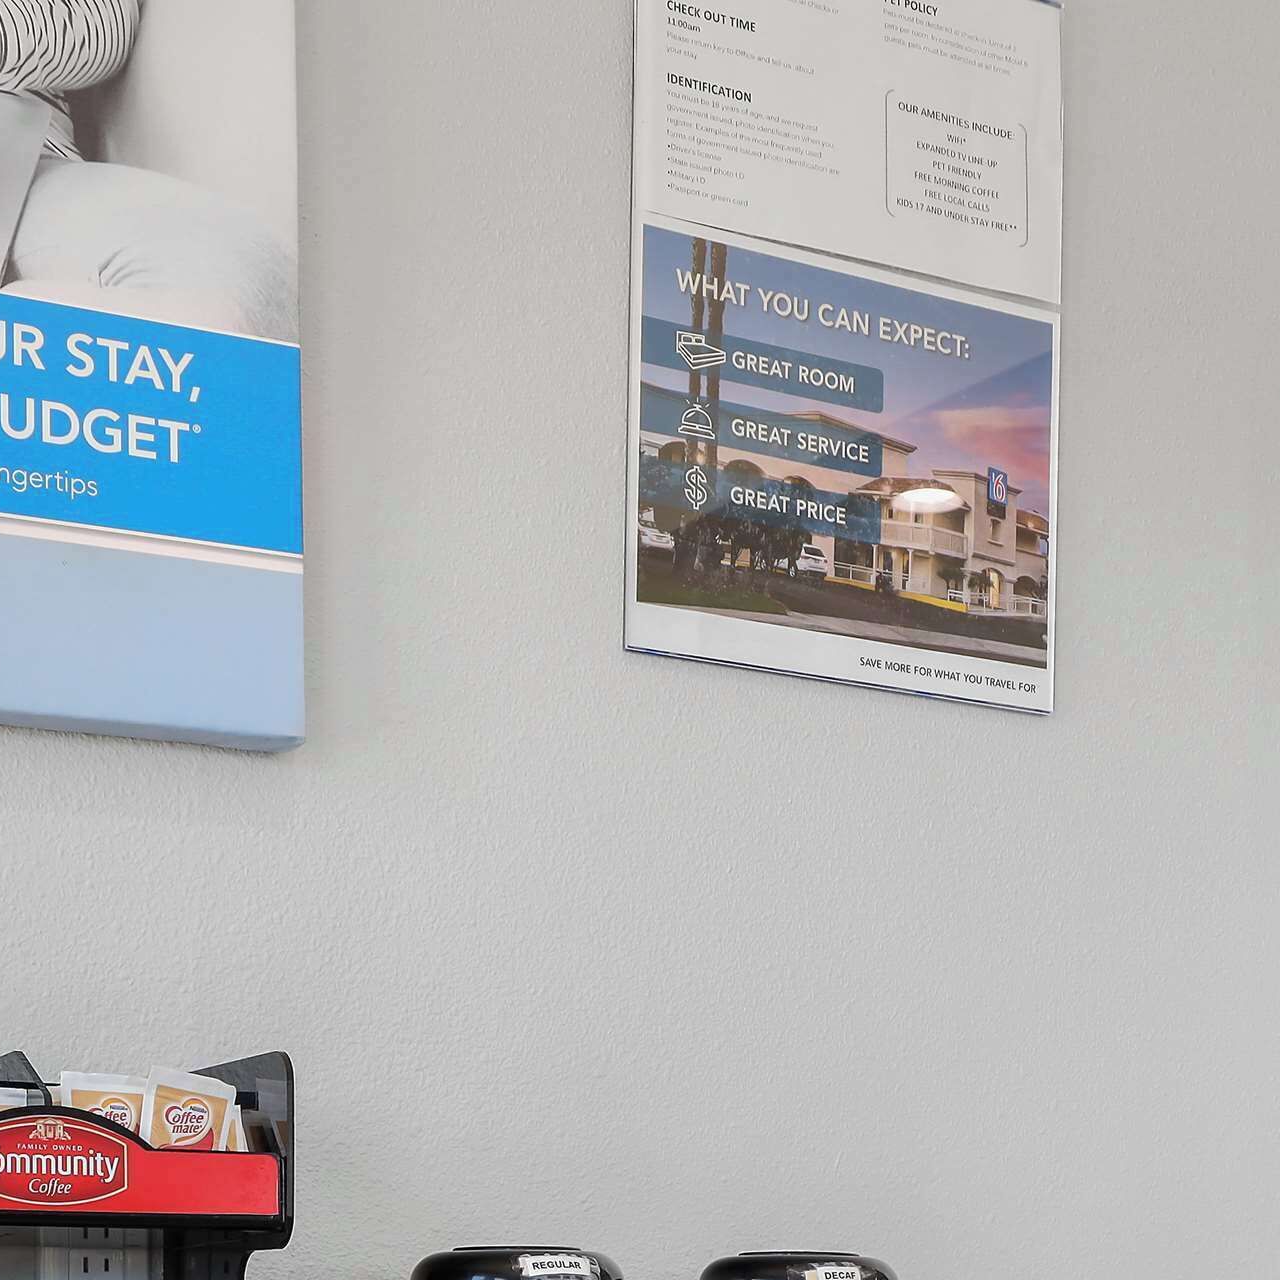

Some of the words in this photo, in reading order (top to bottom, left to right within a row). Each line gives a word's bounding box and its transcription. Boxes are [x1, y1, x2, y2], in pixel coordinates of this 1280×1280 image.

[666, 0, 700, 18] CHECK
[704, 10, 726, 24] OUT
[729, 16, 756, 32] TIME
[904, 0, 938, 16] POLICY
[667, 72, 752, 102] IDENTIFICATION
[898, 101, 918, 114] OUR
[921, 107, 969, 128] AMENITIES
[972, 121, 1015, 140] INCLUDE:
[916, 140, 955, 158] EXPANDED
[957, 151, 966, 161] TV
[914, 170, 931, 182] FREE
[934, 175, 969, 193] MORNING
[971, 185, 999, 200] COFFEE
[932, 160, 945, 171] PET
[947, 164, 981, 180] FRIENDLY
[896, 196, 913, 208] KIDS
[915, 201, 923, 211] 17
[926, 204, 942, 216] AND
[944, 208, 969, 223] UNDER
[970, 215, 989, 228] STAY
[924, 188, 941, 200] FREE
[943, 193, 964, 207] LOCAL
[967, 199, 989, 213] CALLS
[676, 268, 750, 307] WHAT
[757, 287, 809, 321] YOU
[818, 304, 870, 336] CAN
[879, 317, 970, 358] EXPECT:
[65, 332, 201, 404] STAY,
[732, 351, 792, 379] GREAT
[798, 368, 855, 394] ROOM
[731, 418, 791, 447] GREAT
[797, 432, 870, 463] SERVICE
[730, 486, 790, 513] GREAT
[796, 498, 847, 525] PRICE
[860, 656, 882, 668] SAVE
[884, 661, 911, 674] MORE
[914, 666, 932, 677] FOR
[930, 670, 960, 682] WHAT
[964, 674, 982, 684] YOU
[985, 676, 1016, 690] TRAVEL
[1018, 682, 1036, 694] FOR
[164, 1105, 205, 1124] Coffee
[52, 1144, 82, 1152] OWNED
[28, 1178, 72, 1196] Coffee
[532, 1260, 582, 1271] REGULAR
[824, 1270, 856, 1280] DECAF
